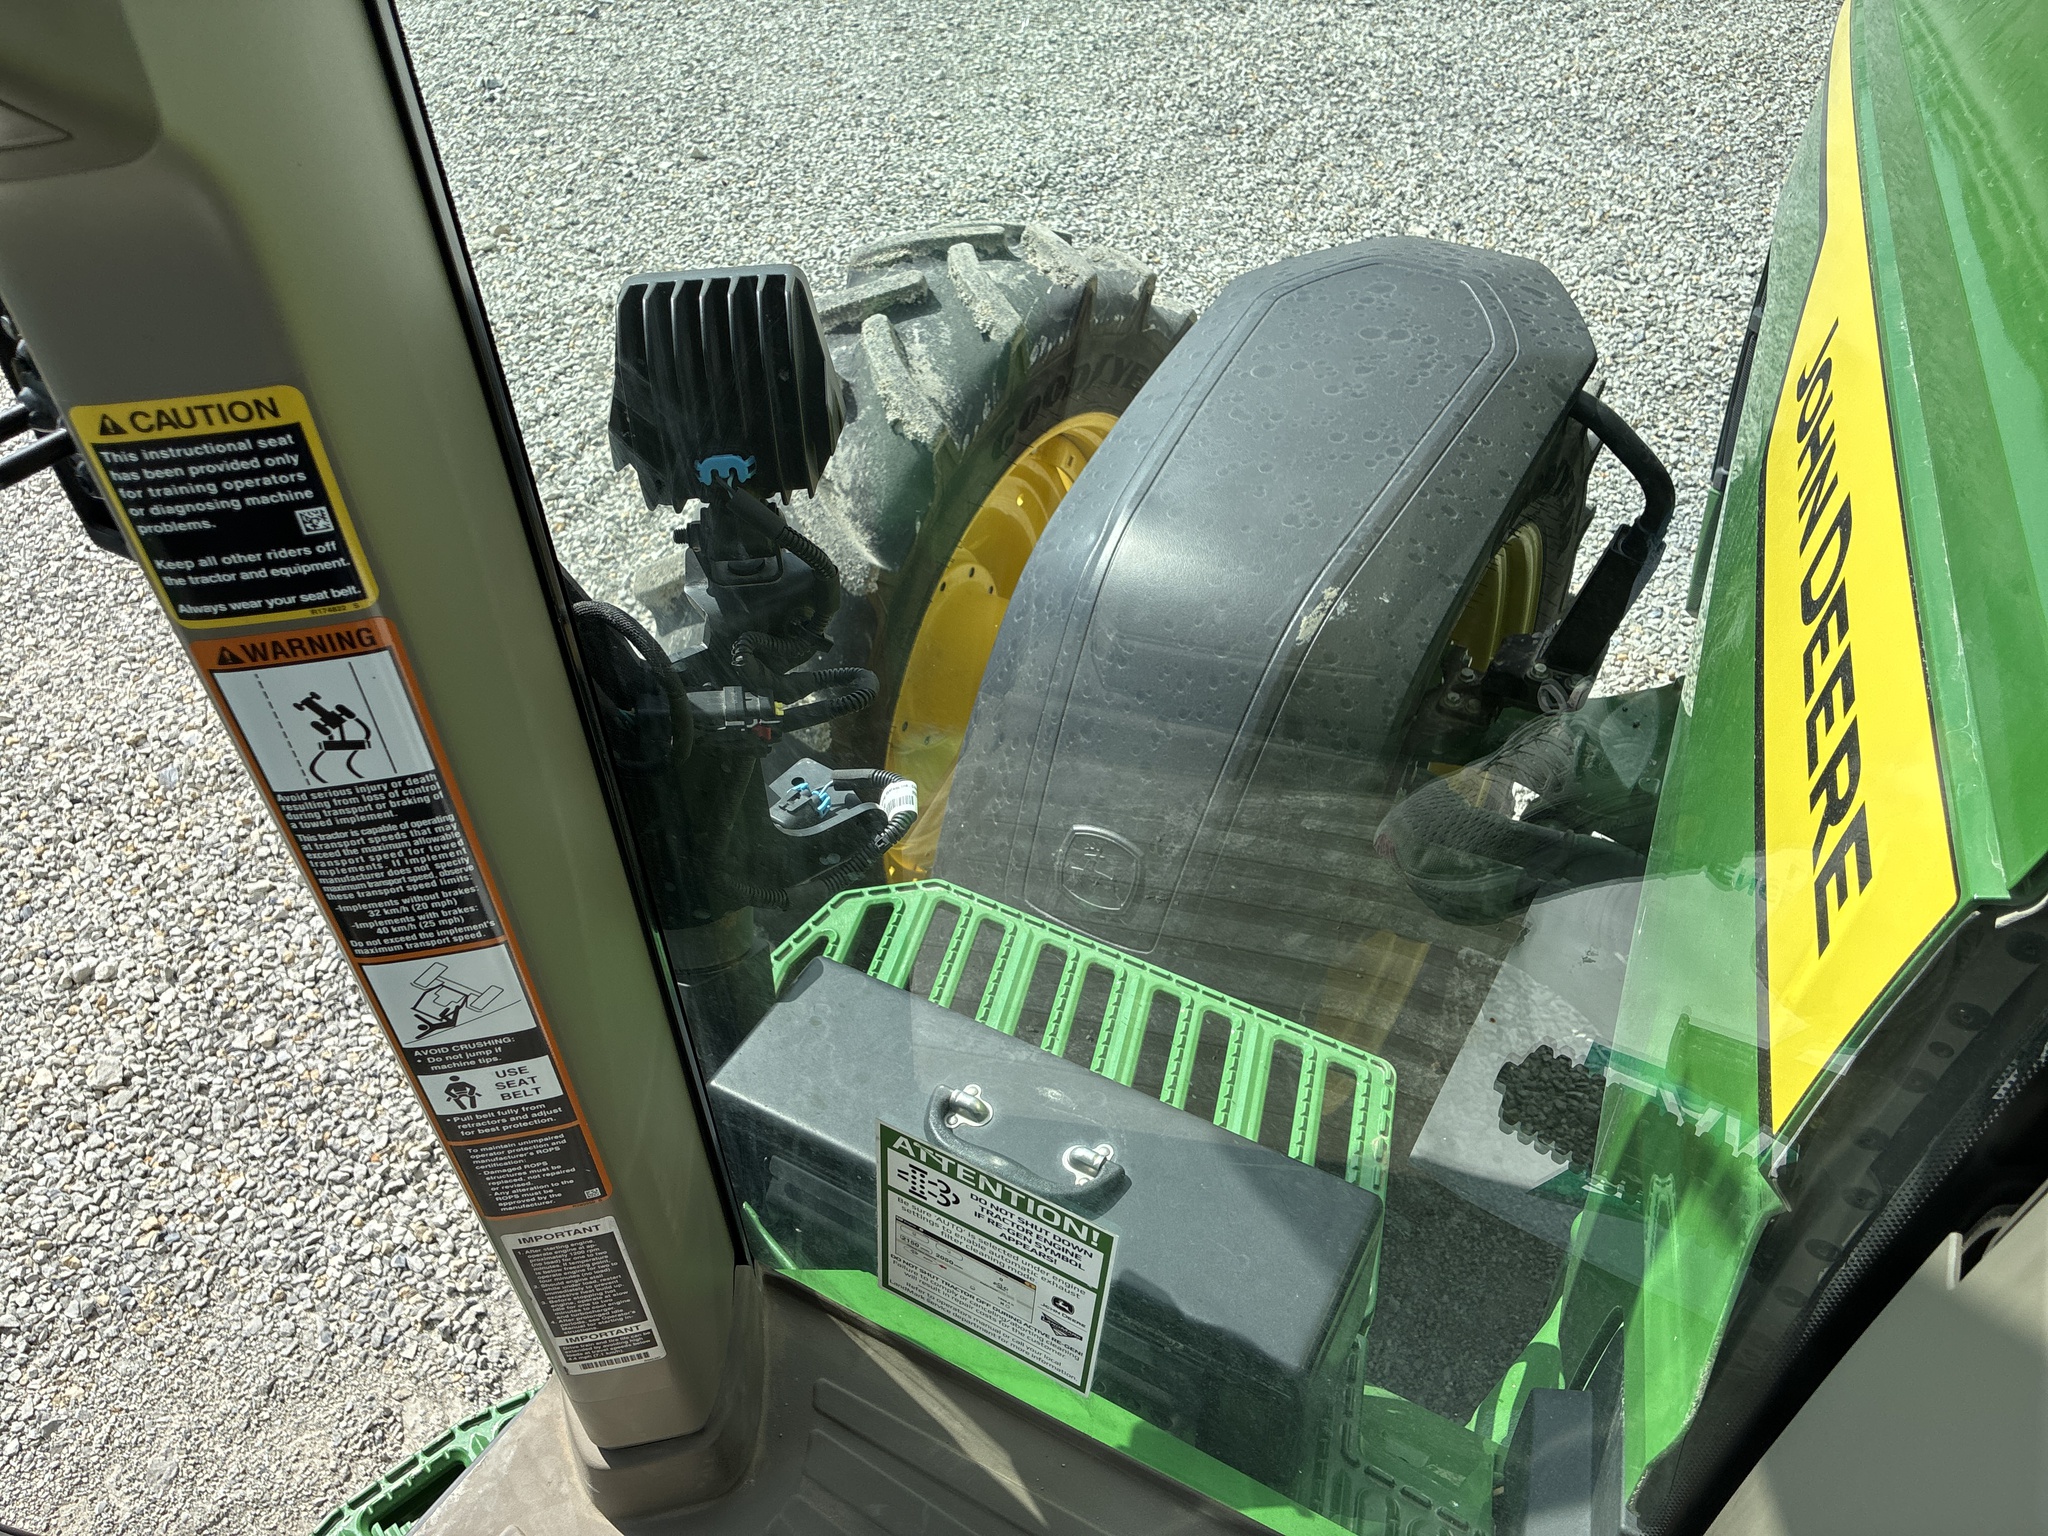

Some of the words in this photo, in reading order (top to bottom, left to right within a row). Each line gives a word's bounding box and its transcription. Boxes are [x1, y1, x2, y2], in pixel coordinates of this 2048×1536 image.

[130, 398, 280, 432] CAUTION
[992, 353, 1151, 462] GOODYE
[99, 451, 139, 463] This
[142, 439, 252, 460] instructional
[257, 434, 295, 448] seat
[1797, 317, 1843, 558] JOHN
[109, 470, 140, 481] has
[141, 467, 185, 479] been
[188, 457, 261, 477] provided
[264, 453, 299, 467] only
[118, 488, 143, 499] for
[147, 483, 218, 497] training
[222, 472, 306, 491] operators
[128, 508, 145, 517] or
[149, 499, 242, 516] diagnosing
[244, 490, 314, 506] machine
[136, 520, 216, 535] problems.
[154, 559, 195, 571] Keep
[197, 556, 218, 567] all
[221, 553, 262, 565] other
[266, 547, 312, 559] riders
[315, 540, 337, 553] off
[162, 576, 187, 586] the
[187, 573, 236, 584] tractor
[239, 568, 268, 579] and
[270, 558, 350, 577] equipment.
[178, 604, 227, 614] Always
[228, 600, 262, 610] wear
[265, 596, 296, 609] your
[299, 590, 330, 602] seat
[330, 585, 361, 597] belt.
[240, 628, 377, 663] WARNING
[1800, 492, 1873, 960] DEERE
[277, 792, 308, 802] Avoid
[310, 788, 353, 799] serious
[354, 783, 388, 793] injury
[390, 780, 402, 788] or
[405, 773, 437, 785] death
[281, 801, 331, 811] resulting
[332, 797, 360, 806] from
[361, 793, 386, 802] loss
[388, 789, 400, 798] of
[401, 781, 441, 796] control
[285, 811, 321, 820] during
[322, 803, 373, 817] transport
[388, 795, 431, 808] braking
[432, 790, 444, 799] of
[298, 818, 333, 828] towed
[335, 810, 398, 825] implement.
[296, 834, 318, 842] This
[317, 831, 349, 840] tractor
[349, 829, 360, 837] is
[360, 824, 398, 835] capable
[399, 821, 410, 829] of
[410, 813, 455, 828] operating
[314, 837, 366, 850] transport
[367, 832, 408, 844] speeds
[409, 827, 432, 837] that
[434, 823, 457, 833] may
[305, 849, 341, 859] exceed
[360, 841, 411, 853] maximum
[413, 831, 461, 845] allowable
[309, 856, 365, 867] transport
[368, 849, 404, 862] speed
[407, 847, 425, 855] for
[428, 838, 464, 852] towed
[314, 863, 388, 876] implements.
[391, 859, 401, 867] If
[404, 847, 468, 865] implement
[318, 872, 384, 884] manufacturer
[386, 867, 412, 876] does
[413, 863, 430, 872] not
[434, 856, 470, 869] specify
[322, 883, 367, 892] maximum
[366, 876, 407, 888] transport
[438, 864, 475, 877] observe
[356, 885, 404, 898] transport
[405, 880, 438, 891] speed
[439, 874, 473, 885] limits:
[367, 909, 381, 917] 32
[382, 906, 410, 915] km/h
[411, 902, 429, 912] (20
[430, 898, 458, 908] mph)
[401, 892, 440, 904] without
[441, 884, 480, 897] brakes:
[390, 923, 417, 933] km/h
[418, 920, 436, 930] (25
[438, 915, 465, 926] mph)
[417, 911, 440, 920] with
[440, 905, 478, 916] brakes:
[354, 945, 404, 954] maximum
[404, 936, 451, 949] transport
[452, 931, 486, 942] speed.
[365, 938, 382, 946] not
[383, 933, 418, 944] exceed
[414, 1047, 449, 1056] AVOID
[451, 1037, 515, 1051] CRUSHING:
[445, 1053, 463, 1061] not
[465, 1049, 493, 1059] jump
[430, 1060, 476, 1071] machine
[477, 1056, 502, 1064] tips.
[495, 1066, 529, 1078] USE
[495, 1076, 537, 1090] SEAT
[500, 1086, 541, 1101] BELT
[457, 1118, 507, 1129] retractors
[509, 1113, 529, 1122] and
[531, 1107, 562, 1118] adjust
[475, 1112, 495, 1120] belt
[496, 1108, 519, 1116] fully
[521, 1104, 546, 1112] from
[477, 1126, 500, 1134] best
[502, 1117, 556, 1131] protection.
[894, 1137, 1099, 1245] ATTENTION!
[517, 1224, 600, 1244] IMPORTANT
[970, 1193, 988, 1206] DO
[990, 1203, 1015, 1219] NOT
[1017, 1217, 1050, 1236] SHUT
[1052, 1234, 1093, 1258] DOWN
[980, 1206, 1033, 1237] TRACTOR
[1035, 1234, 1081, 1261] ENGINE
[897, 1197, 909, 1206] Be
[911, 1205, 932, 1217] sure
[968, 1232, 976, 1240] is
[978, 1238, 1019, 1261] selected
[1021, 1260, 1049, 1276] under
[1052, 1275, 1086, 1295] engine
[974, 1211, 984, 1219] IF
[987, 1217, 1032, 1244] RE-GEN
[1034, 1241, 1084, 1271] SYMBOL
[999, 1233, 1057, 1265] APPEARS!
[565, 1325, 640, 1343] IMPORTANT
